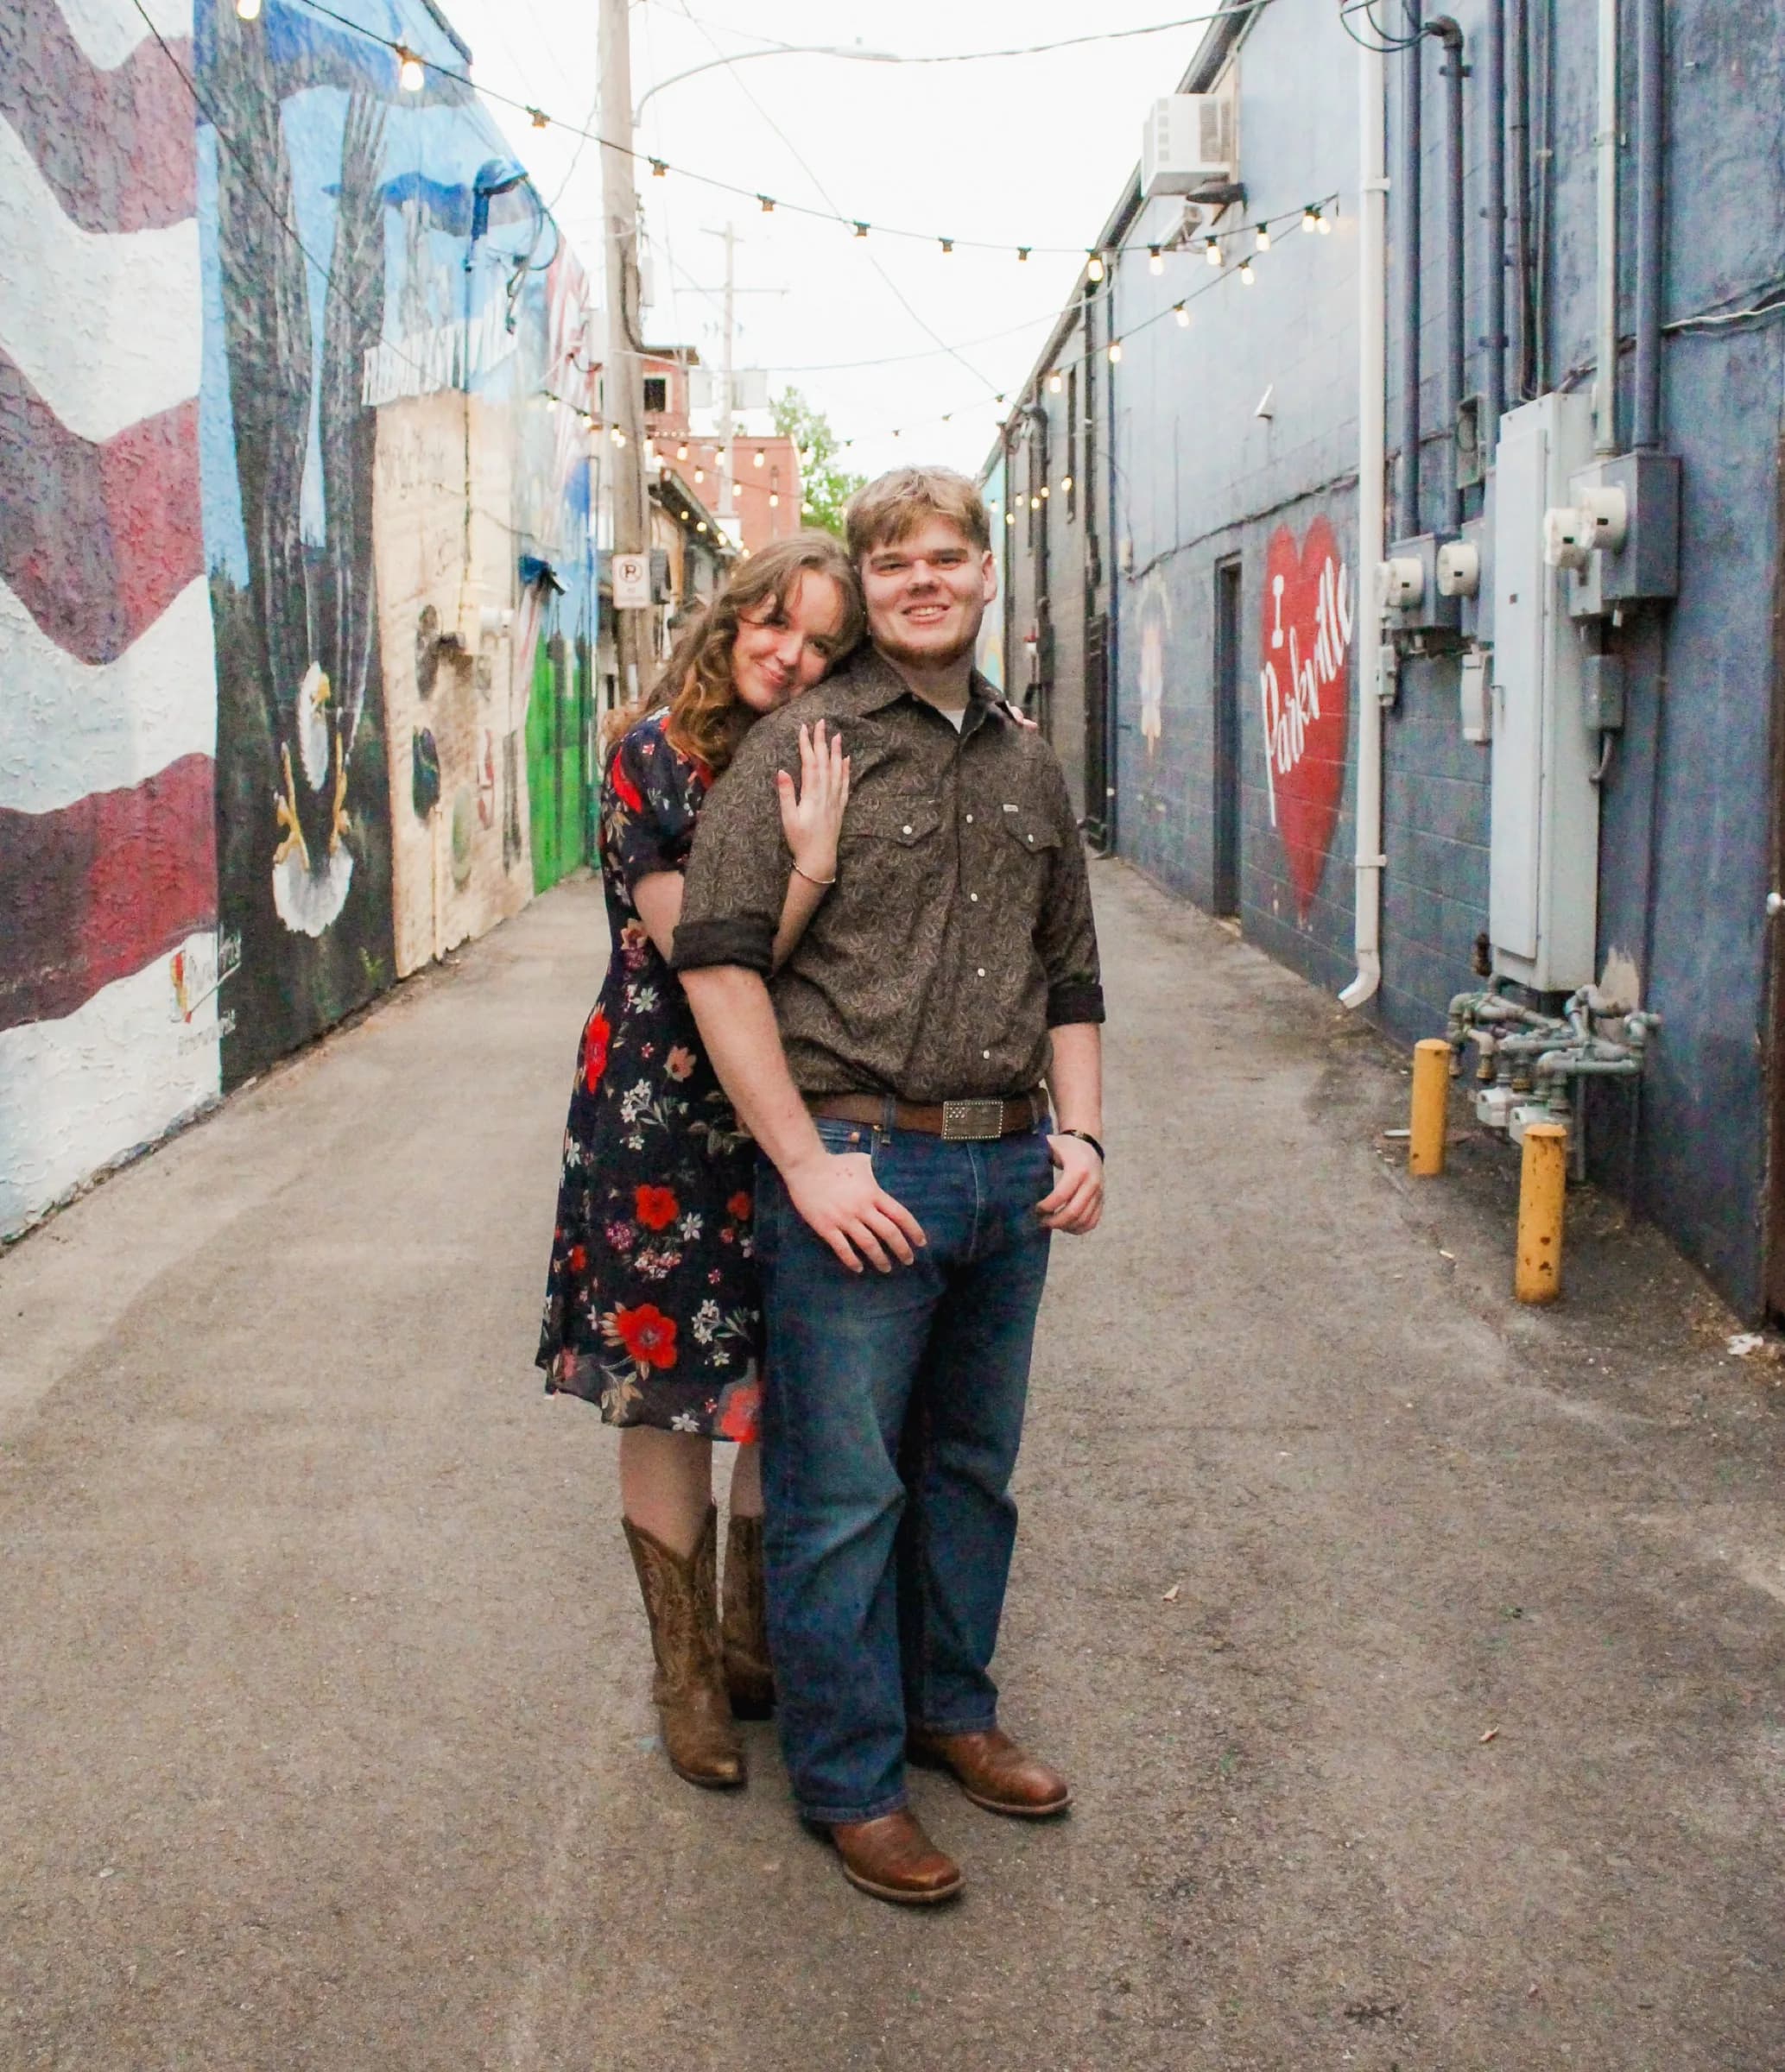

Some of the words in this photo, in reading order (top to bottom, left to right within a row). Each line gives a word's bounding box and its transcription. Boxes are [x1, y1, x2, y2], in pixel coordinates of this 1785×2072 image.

[624, 564, 636, 578] P
[1271, 574, 1285, 649] I
[1260, 556, 1355, 828] Parkville
